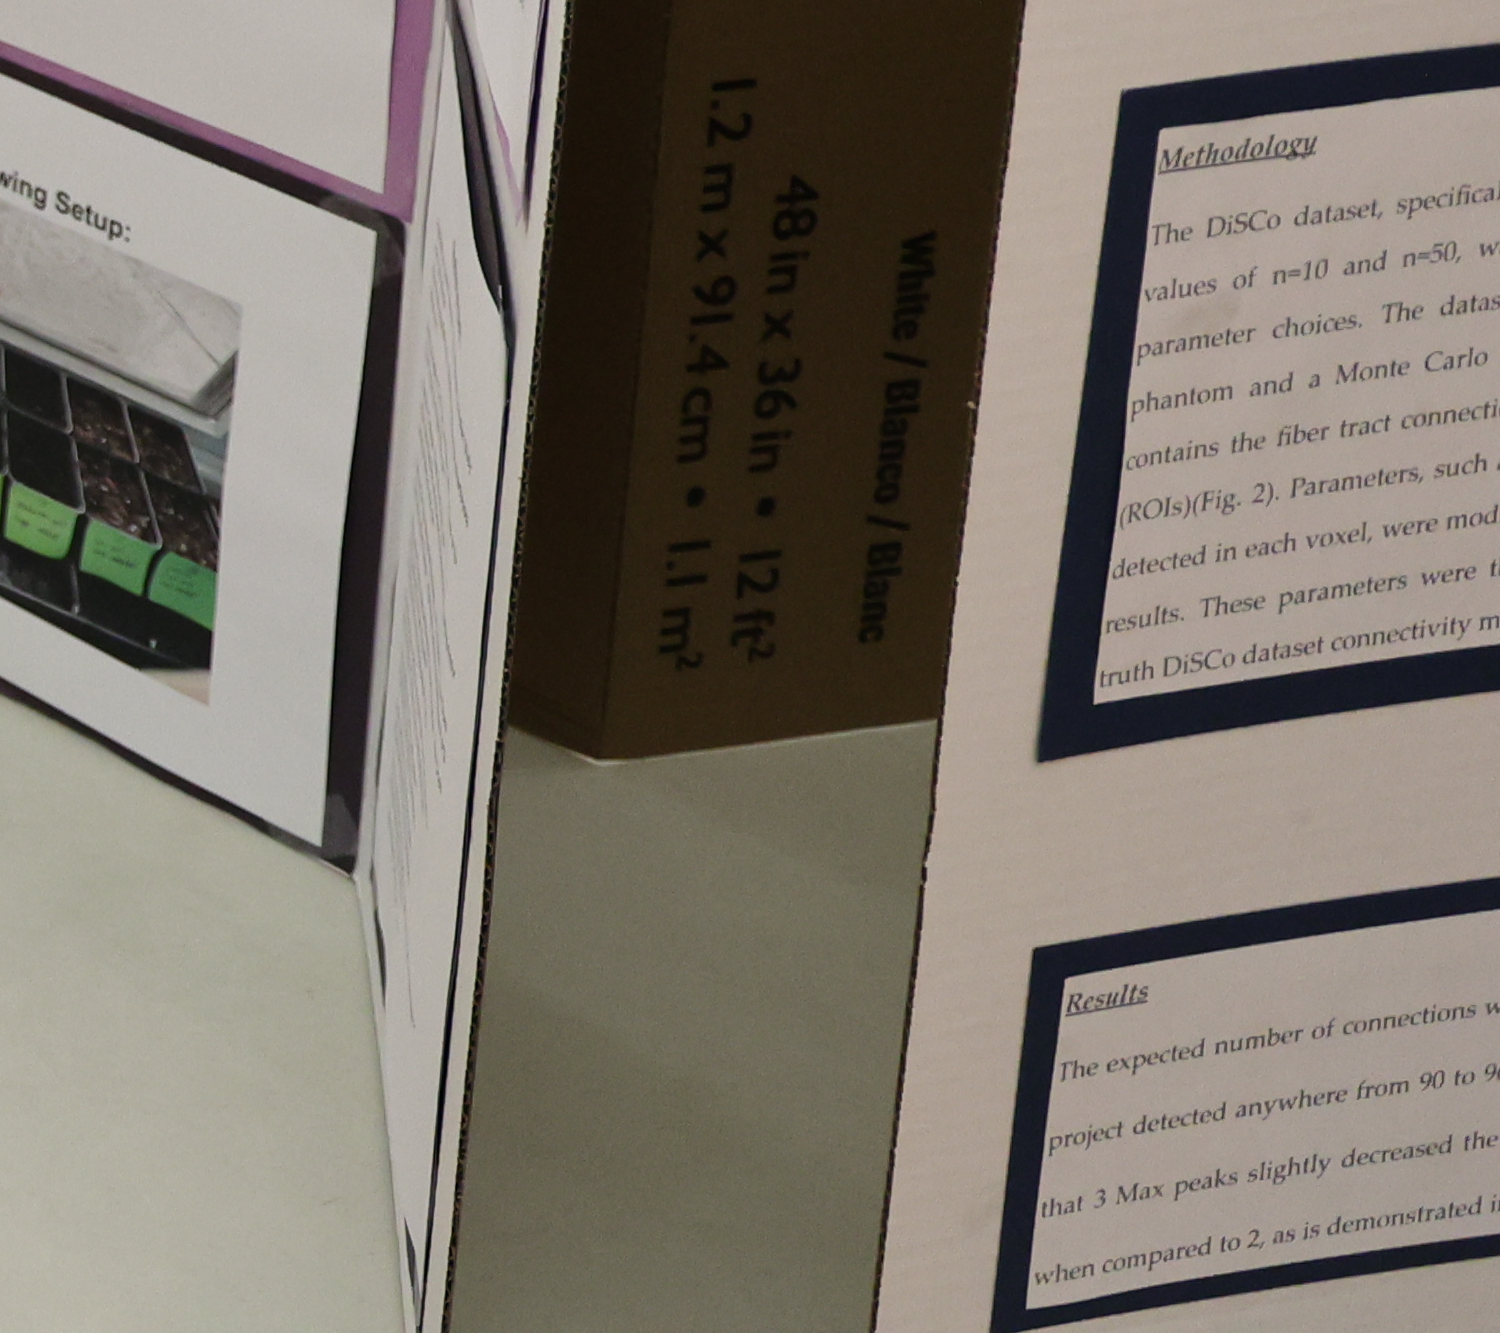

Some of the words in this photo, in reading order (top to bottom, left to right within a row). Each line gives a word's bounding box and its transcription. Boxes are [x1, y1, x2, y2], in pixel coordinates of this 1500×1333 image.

[1161, 134, 1318, 173] Methodology
[55, 191, 130, 242] Setup:
[1153, 222, 1194, 246] The
[1206, 209, 1281, 238] DiSCo
[1293, 199, 1383, 227] dataset,
[890, 230, 938, 342] White
[1146, 278, 1217, 301] values
[1232, 266, 1258, 290] of
[1272, 258, 1329, 285] n=10
[1343, 249, 1387, 276] and
[1403, 240, 1461, 268] n=50,
[1137, 328, 1257, 365] parameter
[1272, 314, 1362, 339] choices.
[1382, 301, 1424, 324] The
[1131, 385, 1234, 421] phantom
[1249, 371, 1294, 397] and
[1308, 374, 1320, 389] a
[1335, 360, 1410, 385] Monte
[1424, 347, 1488, 372] Carlo
[872, 377, 922, 507] Blanco
[1125, 440, 1220, 471] contains
[1231, 431, 1266, 454] the
[1277, 424, 1330, 447] fiber
[1340, 414, 1391, 438] tract
[1251, 482, 1279, 507] 2).
[1290, 467, 1424, 499] Parameters,
[1433, 452, 1487, 479] such
[1113, 544, 1206, 578] detected
[1215, 543, 1237, 563] in
[1245, 532, 1296, 558] each
[1306, 521, 1372, 549] voxel,
[1382, 518, 1439, 538] were
[856, 540, 904, 645] Blanc
[1107, 605, 1184, 632] results.
[1200, 595, 1266, 618] These
[1278, 575, 1407, 615] parameters
[1421, 566, 1477, 586] were
[1101, 660, 1154, 687] truth
[1163, 649, 1236, 677] DiSCo
[1242, 636, 1324, 664] dataset
[1331, 616, 1472, 652] connectivity
[1066, 983, 1148, 1016] Results
[1061, 1060, 1099, 1082] The
[1106, 1038, 1205, 1076] expected
[1215, 1027, 1304, 1055] number
[1311, 1017, 1336, 1040] of
[1342, 1004, 1476, 1035] connections
[1049, 1121, 1123, 1157] project
[1132, 1101, 1226, 1135] detected
[1235, 1089, 1348, 1121] anywhere
[1356, 1080, 1409, 1100] from
[1419, 1070, 1445, 1091] 90
[1454, 1070, 1475, 1086] to
[1042, 1196, 1083, 1218] that
[1094, 1188, 1106, 1209] 3
[1116, 1182, 1164, 1205] Max
[1174, 1168, 1238, 1201] peaks
[1247, 1153, 1331, 1185] slightly
[1341, 1134, 1453, 1168] decreased
[1464, 1131, 1499, 1152] the
[1036, 1263, 1095, 1286] when
[1102, 1238, 1212, 1272] compared
[1219, 1234, 1241, 1253] to
[1247, 1229, 1267, 1252] 2,
[1272, 1227, 1296, 1245] as
[1305, 1222, 1321, 1240] is
[1326, 1196, 1481, 1236] demonstrated
